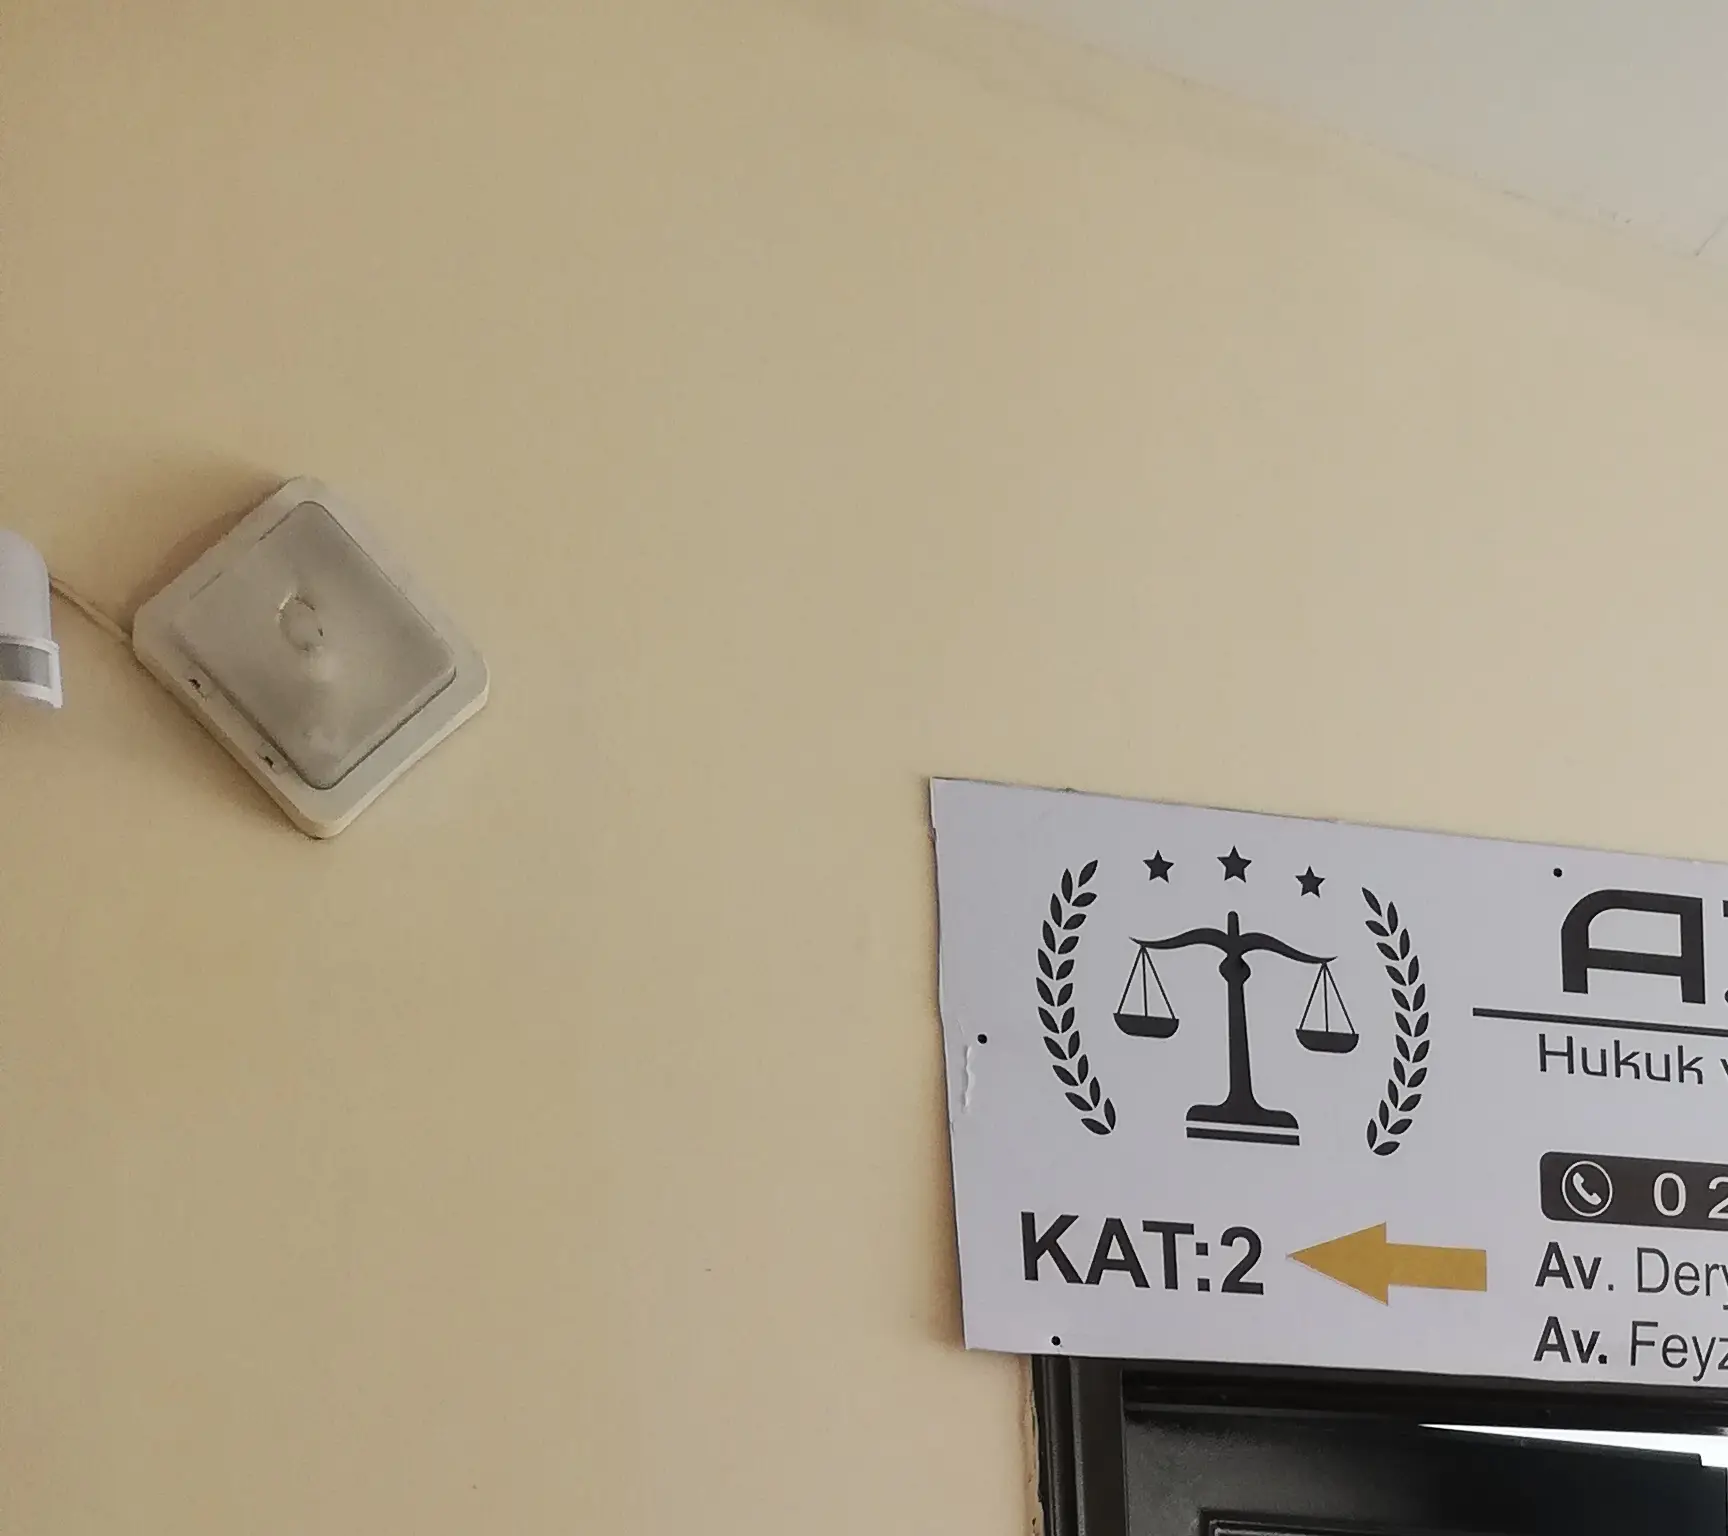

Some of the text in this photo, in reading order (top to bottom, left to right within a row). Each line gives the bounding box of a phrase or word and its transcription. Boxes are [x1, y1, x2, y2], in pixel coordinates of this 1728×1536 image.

[1538, 1033, 1704, 1086] Hukuk
[1653, 1172, 1687, 1218] 0
[1020, 1211, 1266, 1297] KAT:2
[1534, 1241, 1616, 1293] Av.
[1533, 1315, 1608, 1366] Av.
